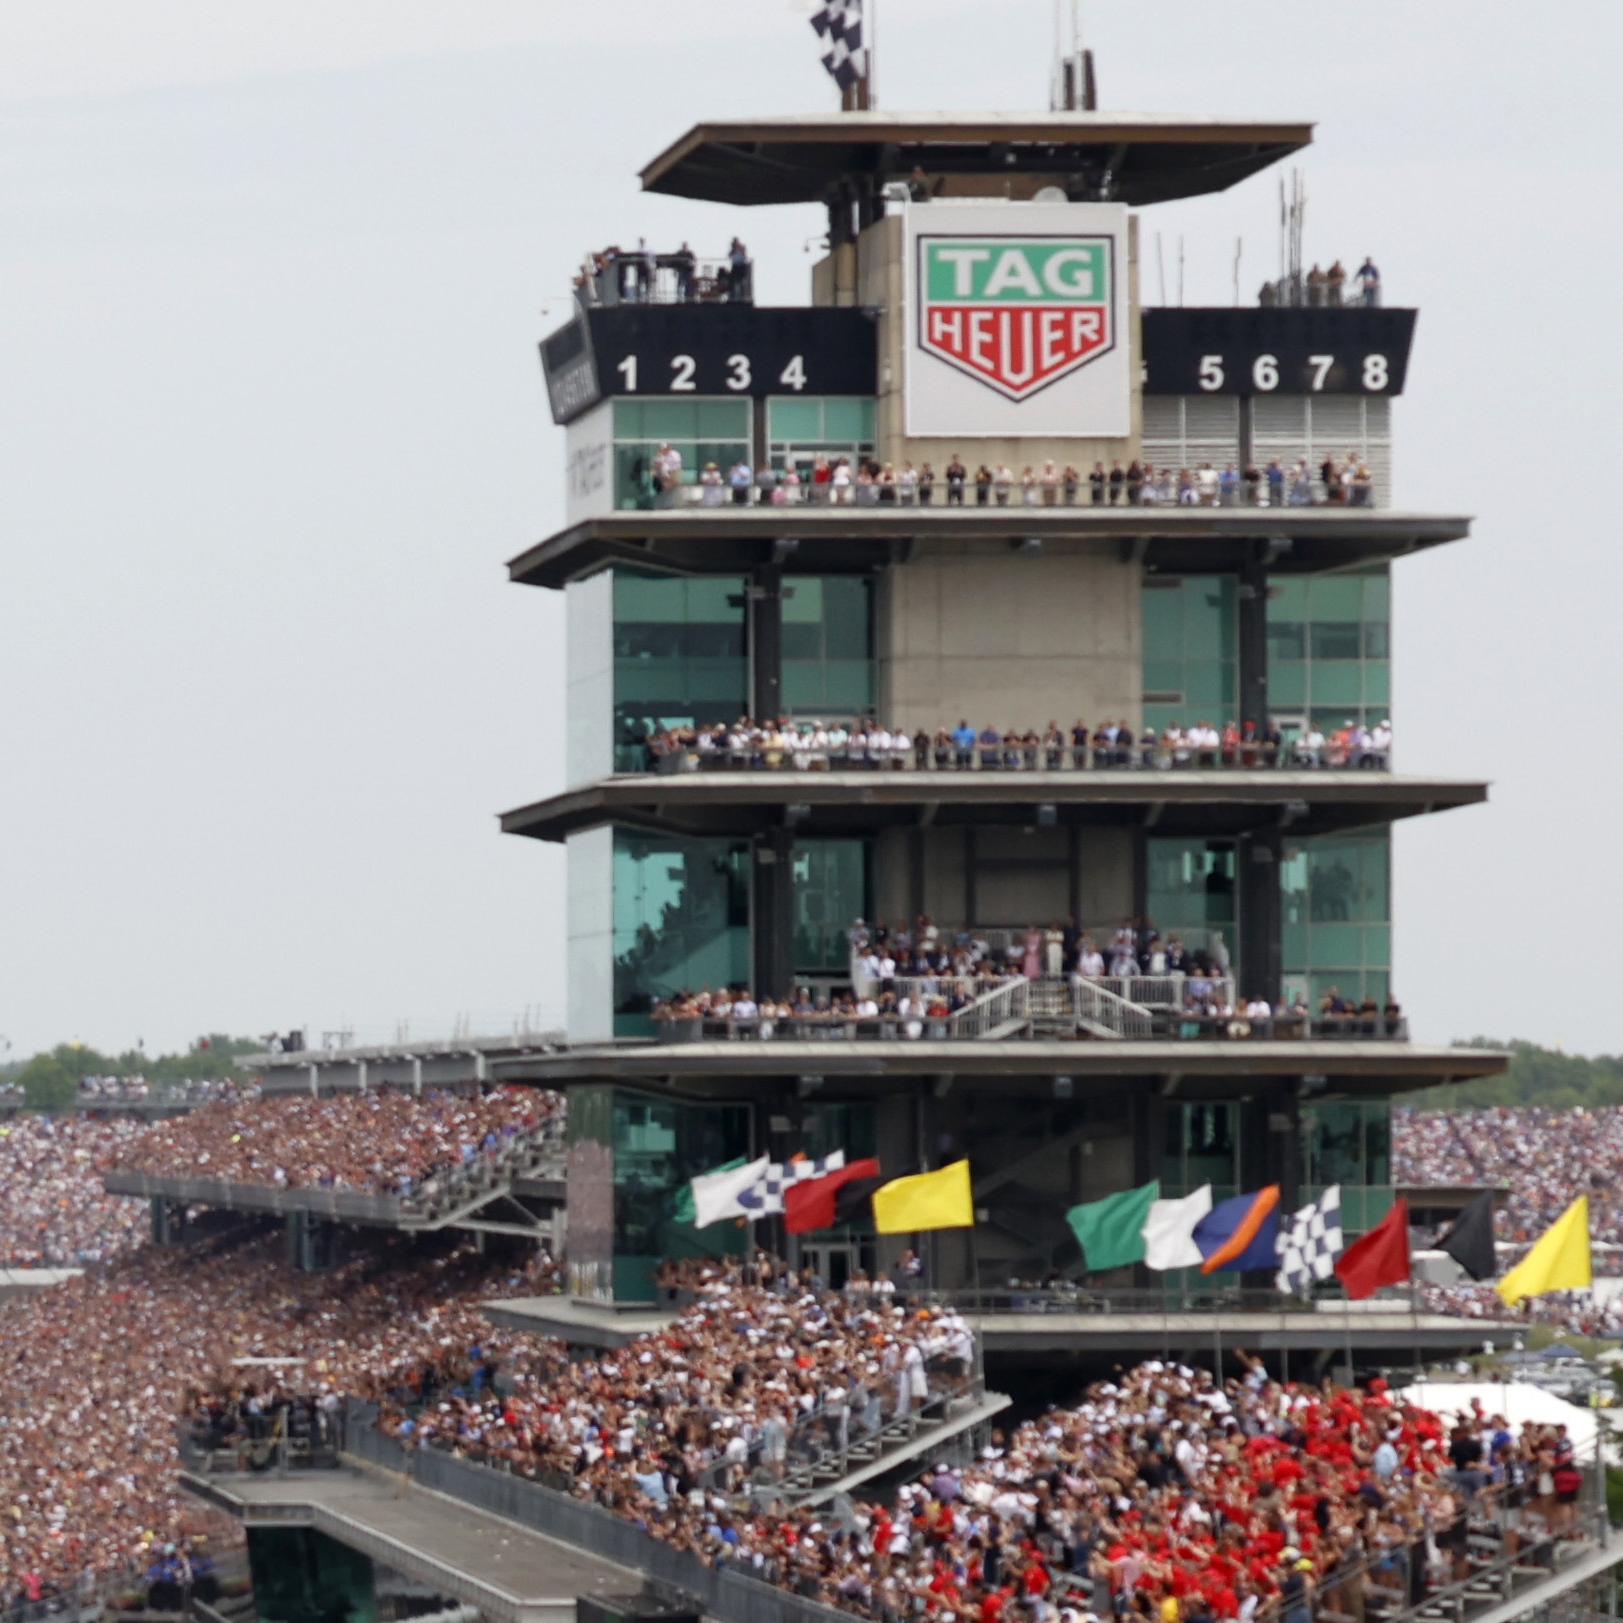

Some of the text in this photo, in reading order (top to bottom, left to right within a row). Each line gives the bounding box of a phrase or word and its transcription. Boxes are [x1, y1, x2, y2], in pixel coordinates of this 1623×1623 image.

[935, 248, 1094, 297] TAG
[932, 310, 1101, 386] HEUER
[617, 355, 638, 390] 1
[670, 355, 696, 390] 2
[726, 354, 752, 390] 3
[780, 355, 807, 390] 4
[1199, 354, 1389, 391] 5 6 7 8
